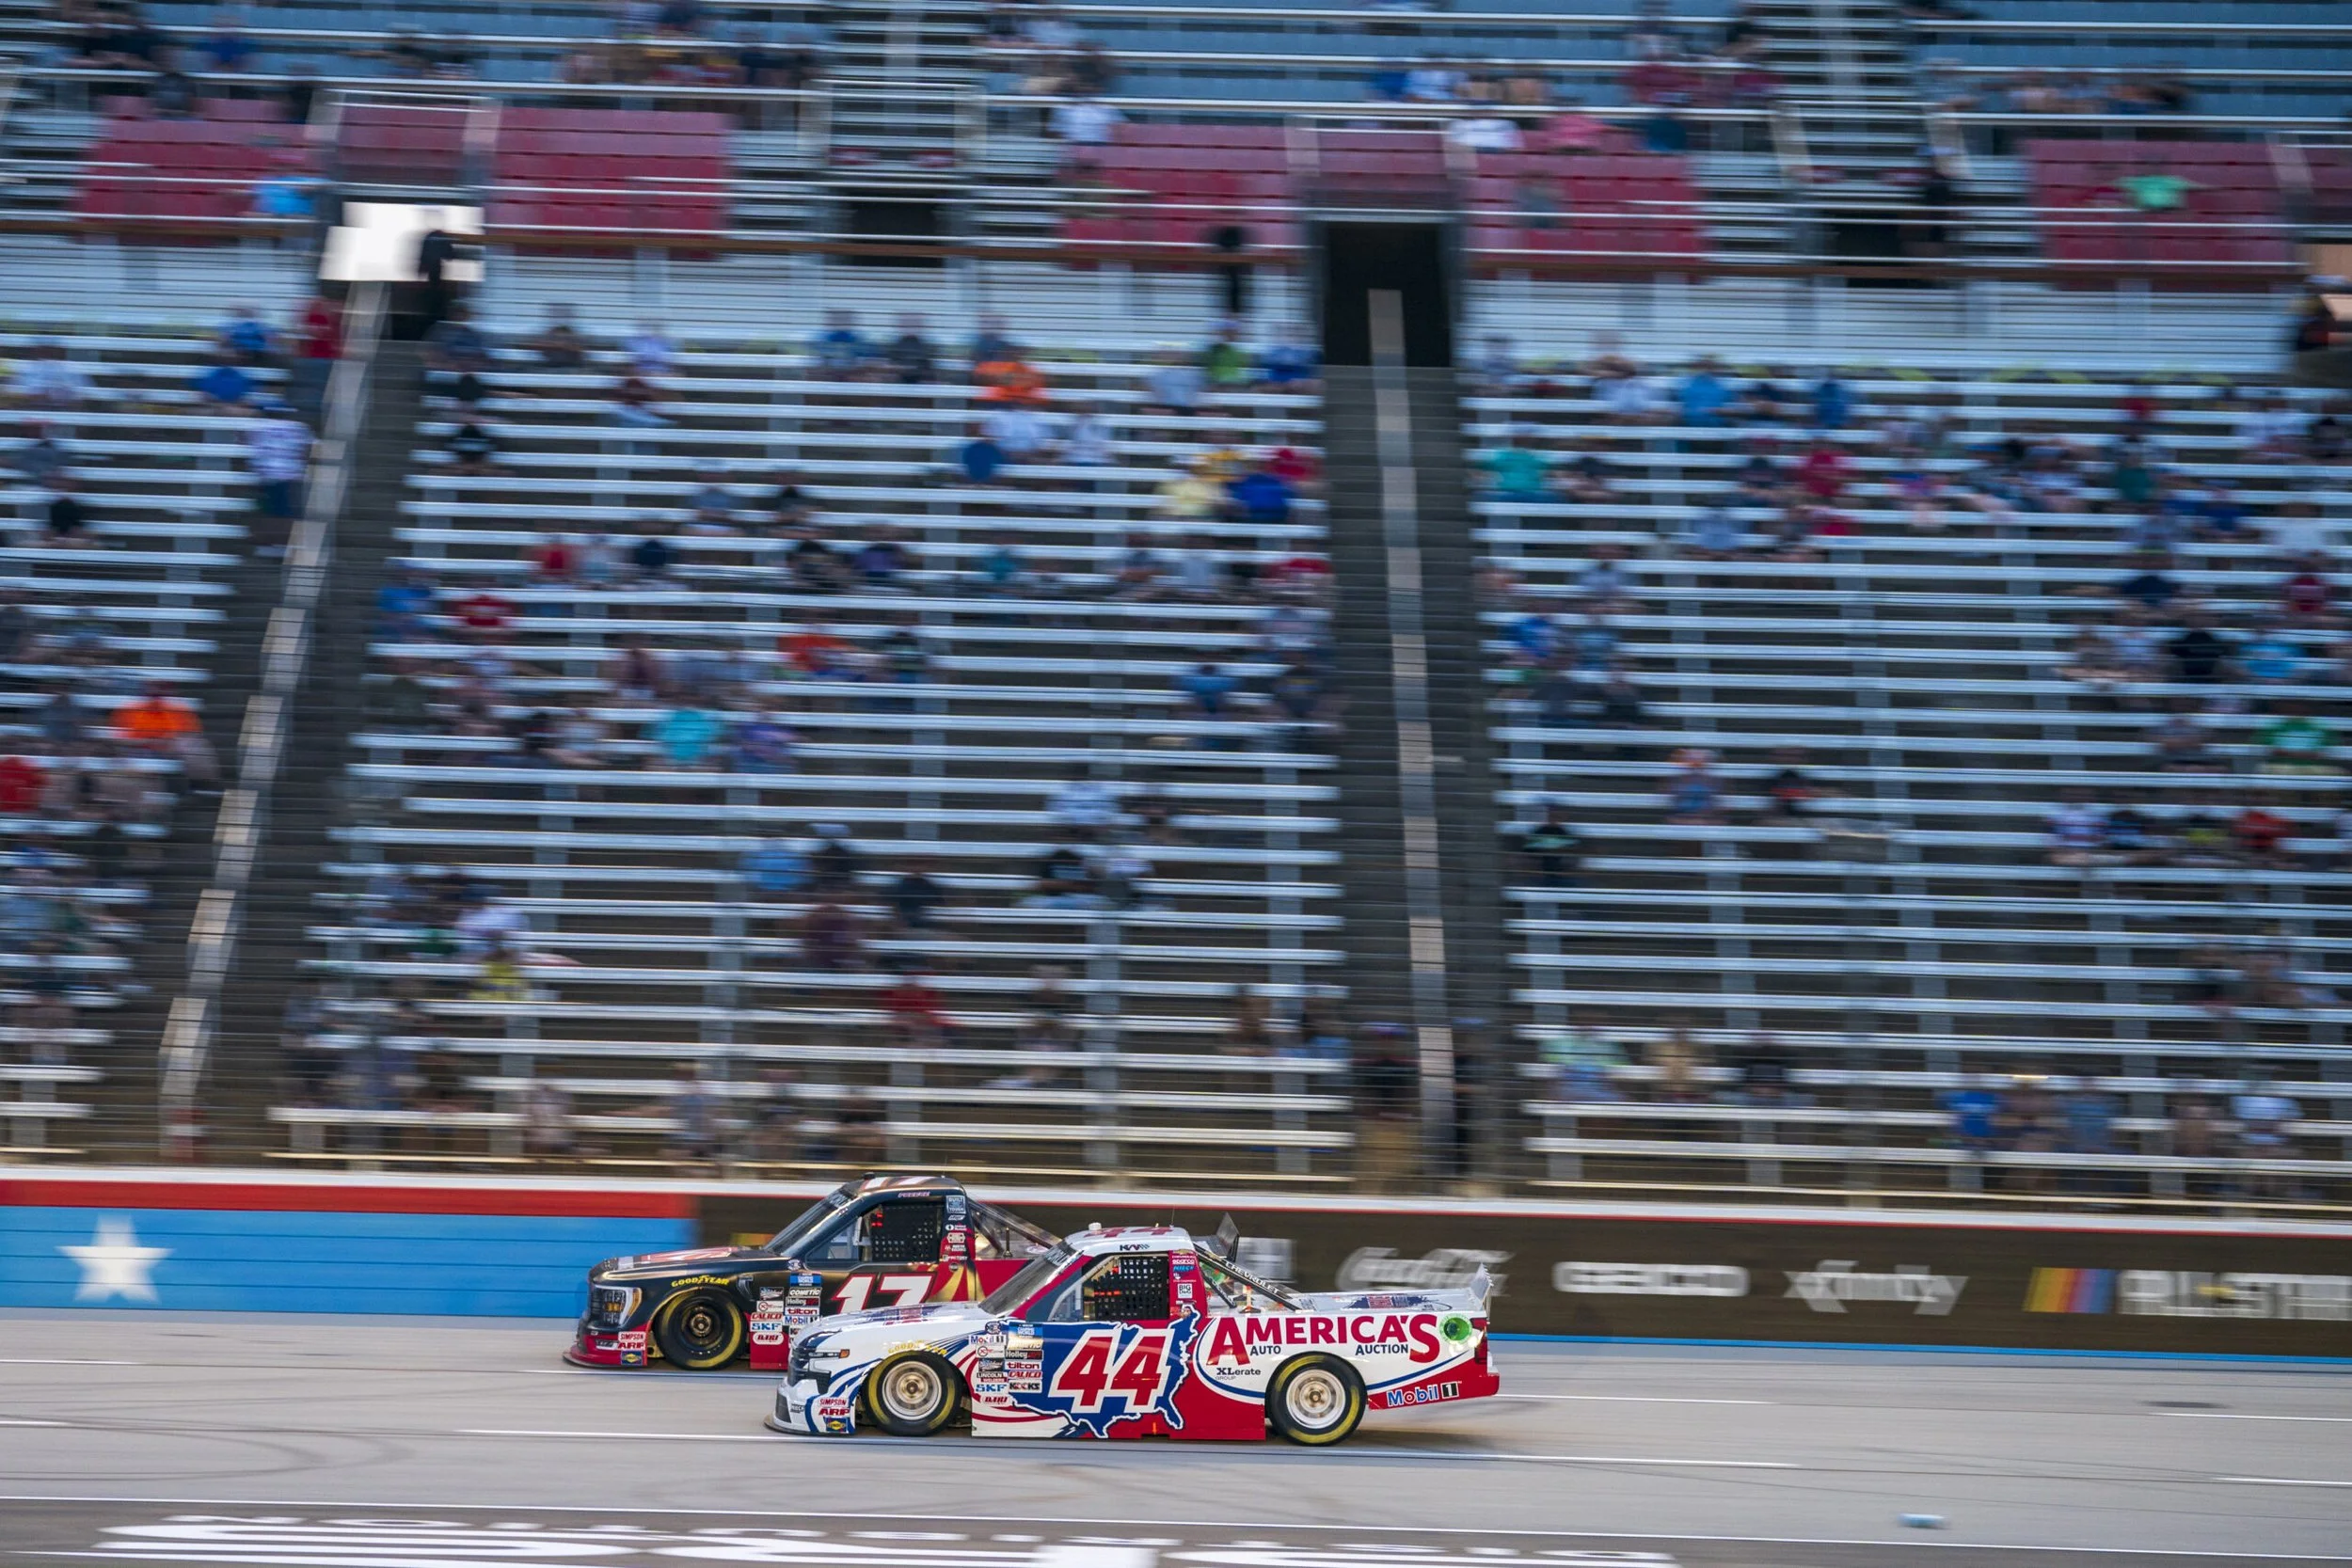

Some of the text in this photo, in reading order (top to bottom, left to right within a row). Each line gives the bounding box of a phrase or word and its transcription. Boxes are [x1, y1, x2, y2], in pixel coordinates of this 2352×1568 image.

[671, 1275, 730, 1288] GOODYEAR
[1225, 1260, 1279, 1294] CHEVROLET
[833, 1274, 935, 1314] 17
[752, 1323, 781, 1331] SKF
[1206, 1314, 1440, 1366] AMERICA'S
[1249, 1343, 1408, 1355] AUTO AUCTION
[1048, 1328, 1175, 1414] 44
[1216, 1367, 1262, 1375] XLerate
[976, 1384, 1007, 1392] SKF
[1387, 1385, 1439, 1407] Mobil
